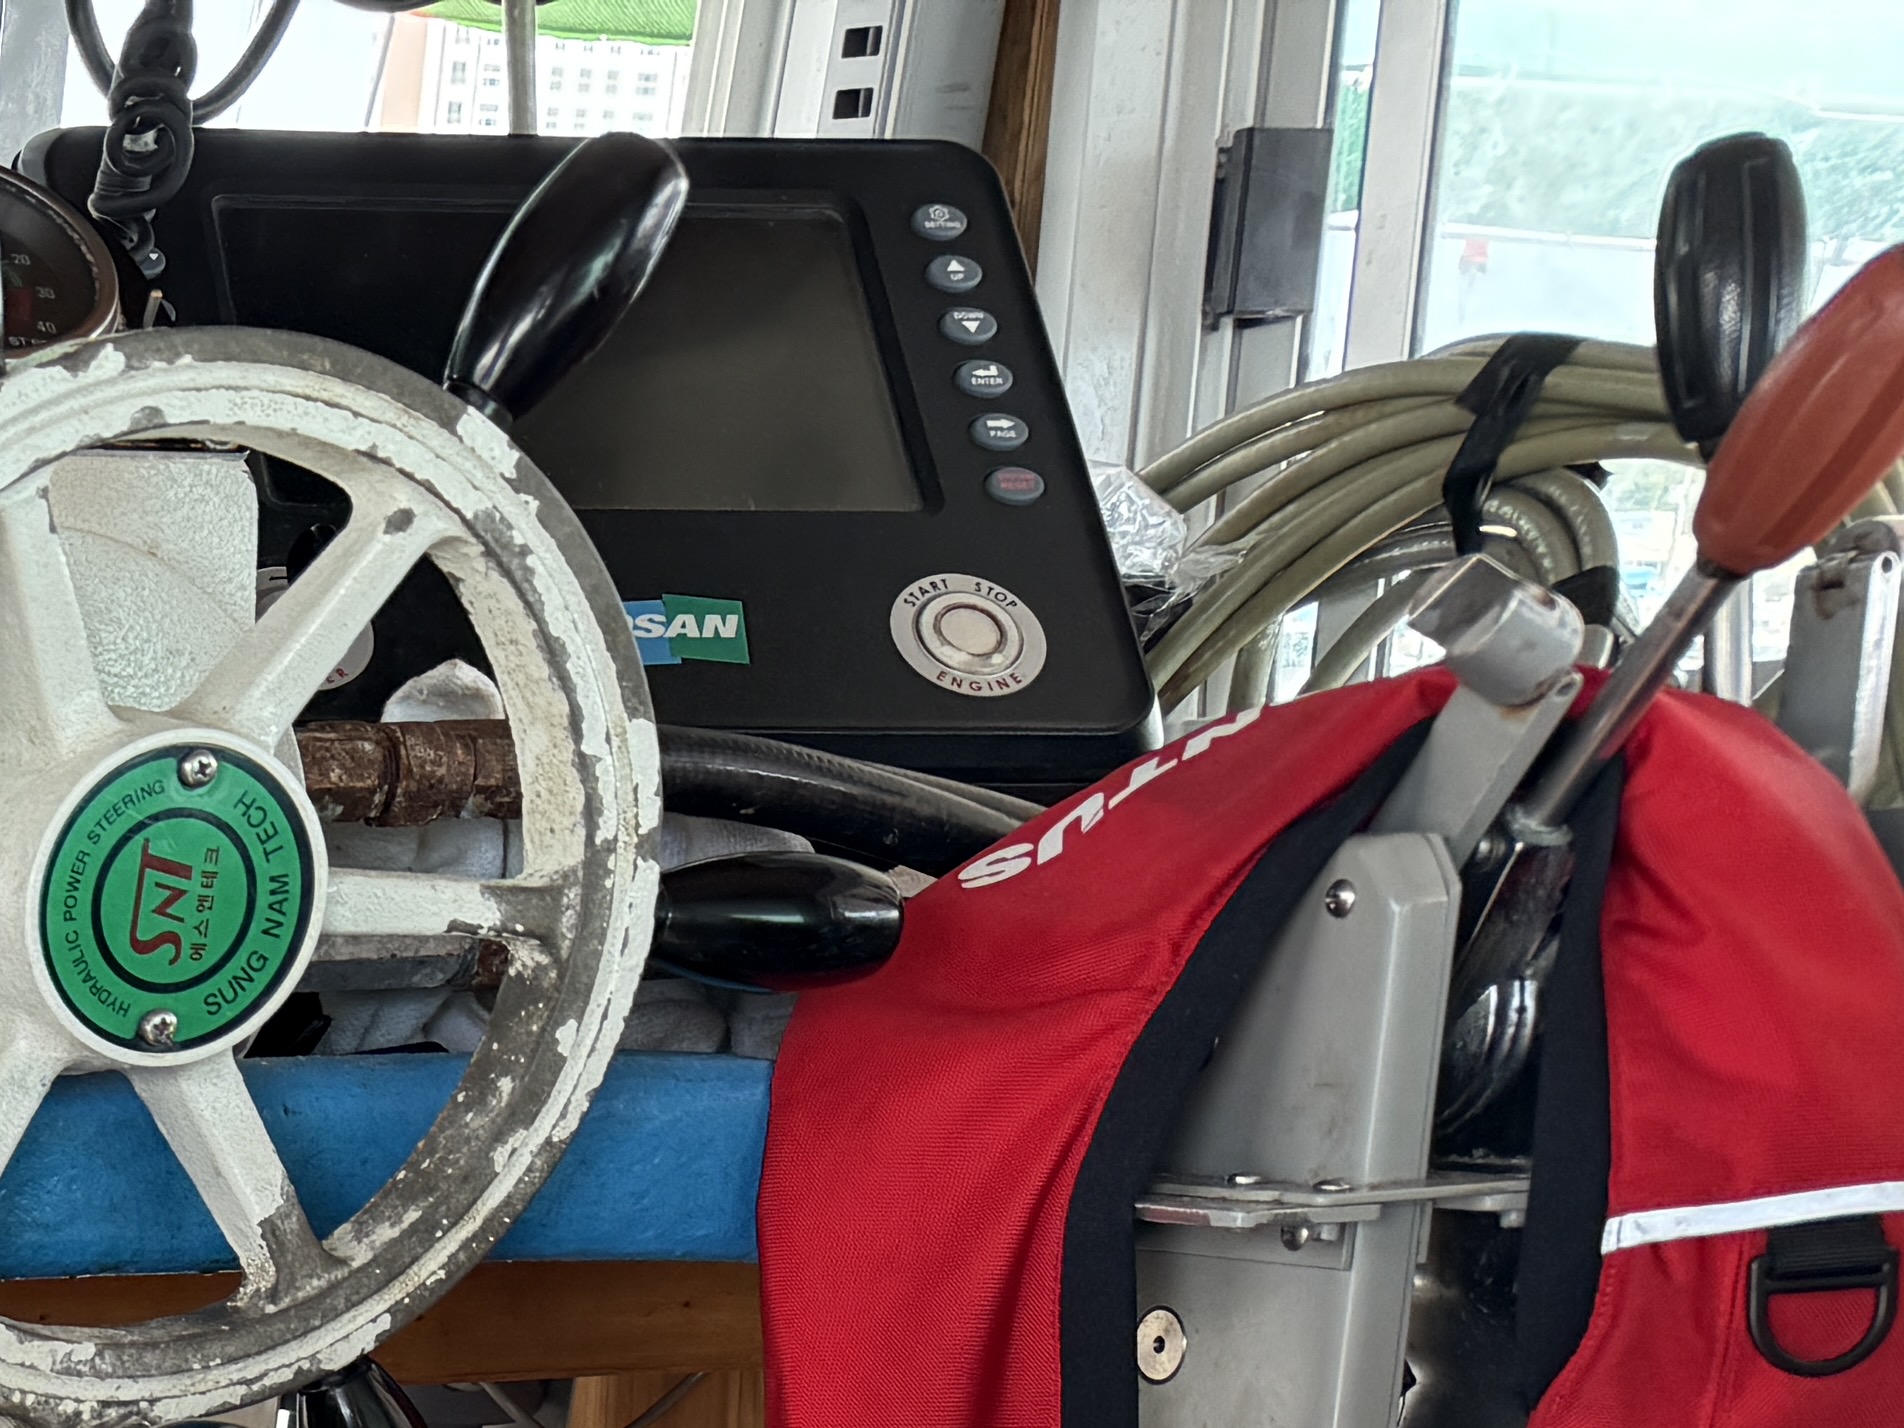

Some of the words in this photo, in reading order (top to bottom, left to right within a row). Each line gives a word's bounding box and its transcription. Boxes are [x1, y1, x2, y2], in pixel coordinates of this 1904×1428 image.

[11, 253, 31, 265] 20
[35, 286, 55, 298] 30
[36, 321, 57, 334] 40
[903, 577, 950, 607] START
[973, 581, 1018, 610] STOP
[936, 670, 1023, 693] ENGINE
[87, 779, 166, 845] STEERING
[233, 789, 284, 864] TECH
[63, 849, 91, 922] POWER
[189, 845, 221, 962] 에스엔테크
[261, 873, 291, 939] NAM
[64, 929, 131, 1019] HYDRAULIC
[203, 949, 269, 1017] SUNG
